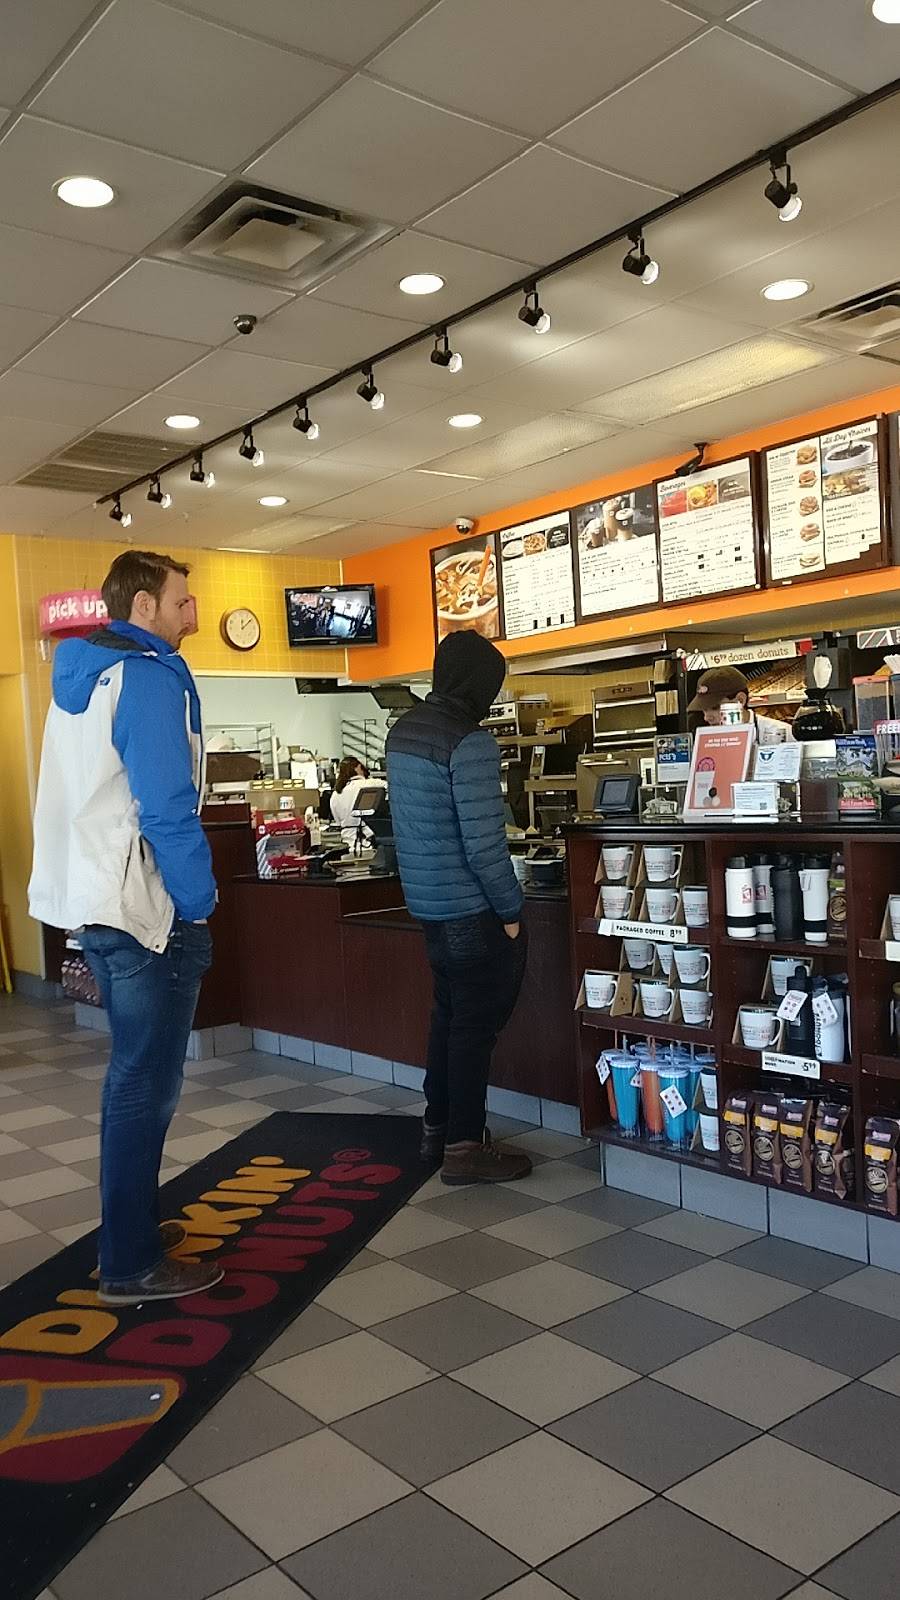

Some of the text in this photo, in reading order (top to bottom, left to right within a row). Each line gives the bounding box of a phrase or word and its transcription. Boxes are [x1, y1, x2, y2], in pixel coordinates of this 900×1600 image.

[48, 597, 108, 623] pick up
[728, 652, 755, 664] dozen
[757, 647, 789, 660] donuts
[616, 925, 644, 933] PACKAGED
[644, 927, 665, 936] COFFEE
